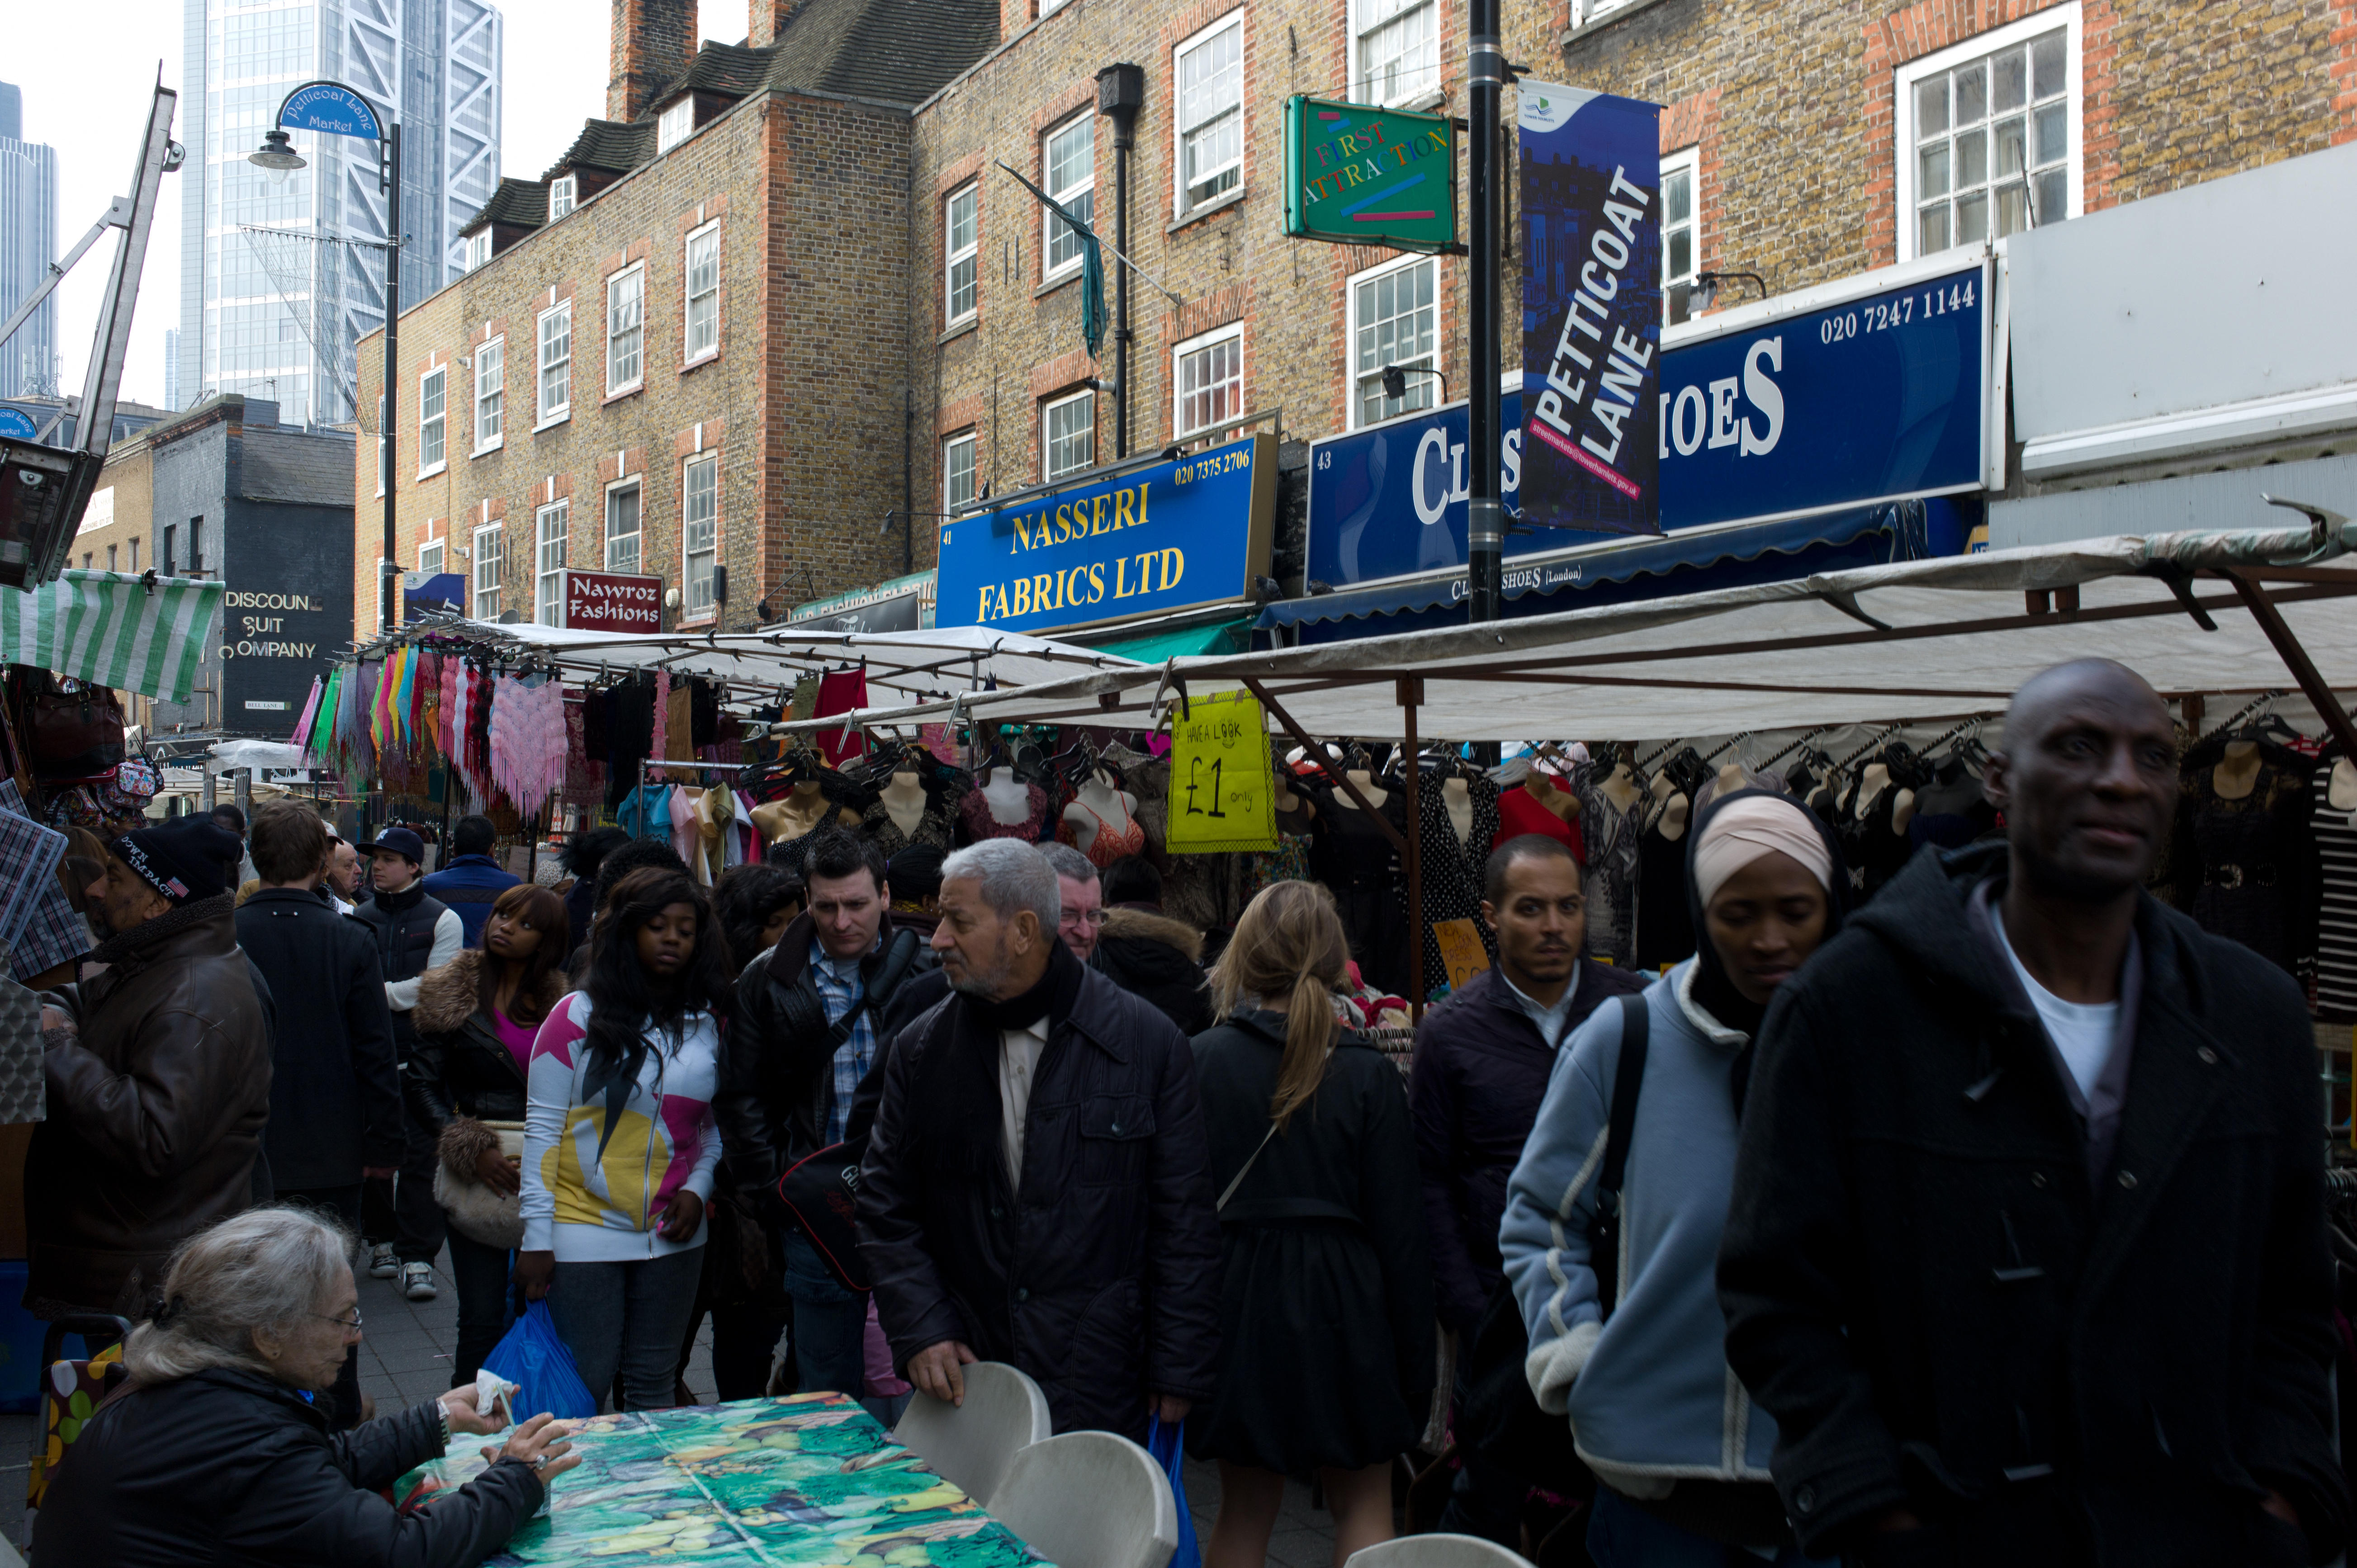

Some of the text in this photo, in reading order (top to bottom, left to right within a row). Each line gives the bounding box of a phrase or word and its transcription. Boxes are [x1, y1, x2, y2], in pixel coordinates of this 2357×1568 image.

[287, 90, 372, 130] Petticoat Lane
[309, 115, 352, 132] Market
[1314, 120, 1385, 167] FIRST
[1305, 127, 1448, 206] ATTRACTION
[1535, 164, 1650, 436] PETTICOAT
[1821, 280, 1975, 344] 020 7247 1144
[1580, 324, 1654, 466] LANE
[1175, 448, 1249, 486] 020 7375 2706
[1317, 451, 1331, 470] 43
[1532, 422, 1638, 497] streetmarkets@towerhamlets.gov.uk
[1010, 482, 1152, 555] NASSERI
[943, 530, 951, 545] 41
[572, 577, 657, 601] Nawroz
[976, 562, 1105, 623] FABRICS
[1113, 547, 1184, 600] LTD
[1501, 567, 1541, 590] SHOES
[1546, 564, 1582, 586] (London)
[226, 591, 309, 610] DISCOUN
[569, 599, 658, 623] Fashions
[242, 616, 284, 637] SUIT
[1187, 722, 1242, 744] HAVE A LOOK
[1186, 756, 1226, 818] £1
[121, 836, 149, 863] DOWN
[128, 855, 175, 898] IMPACT
[1438, 922, 1460, 937] NEW
[1453, 933, 1477, 949] LOOK
[1444, 948, 1472, 963] DRESS
